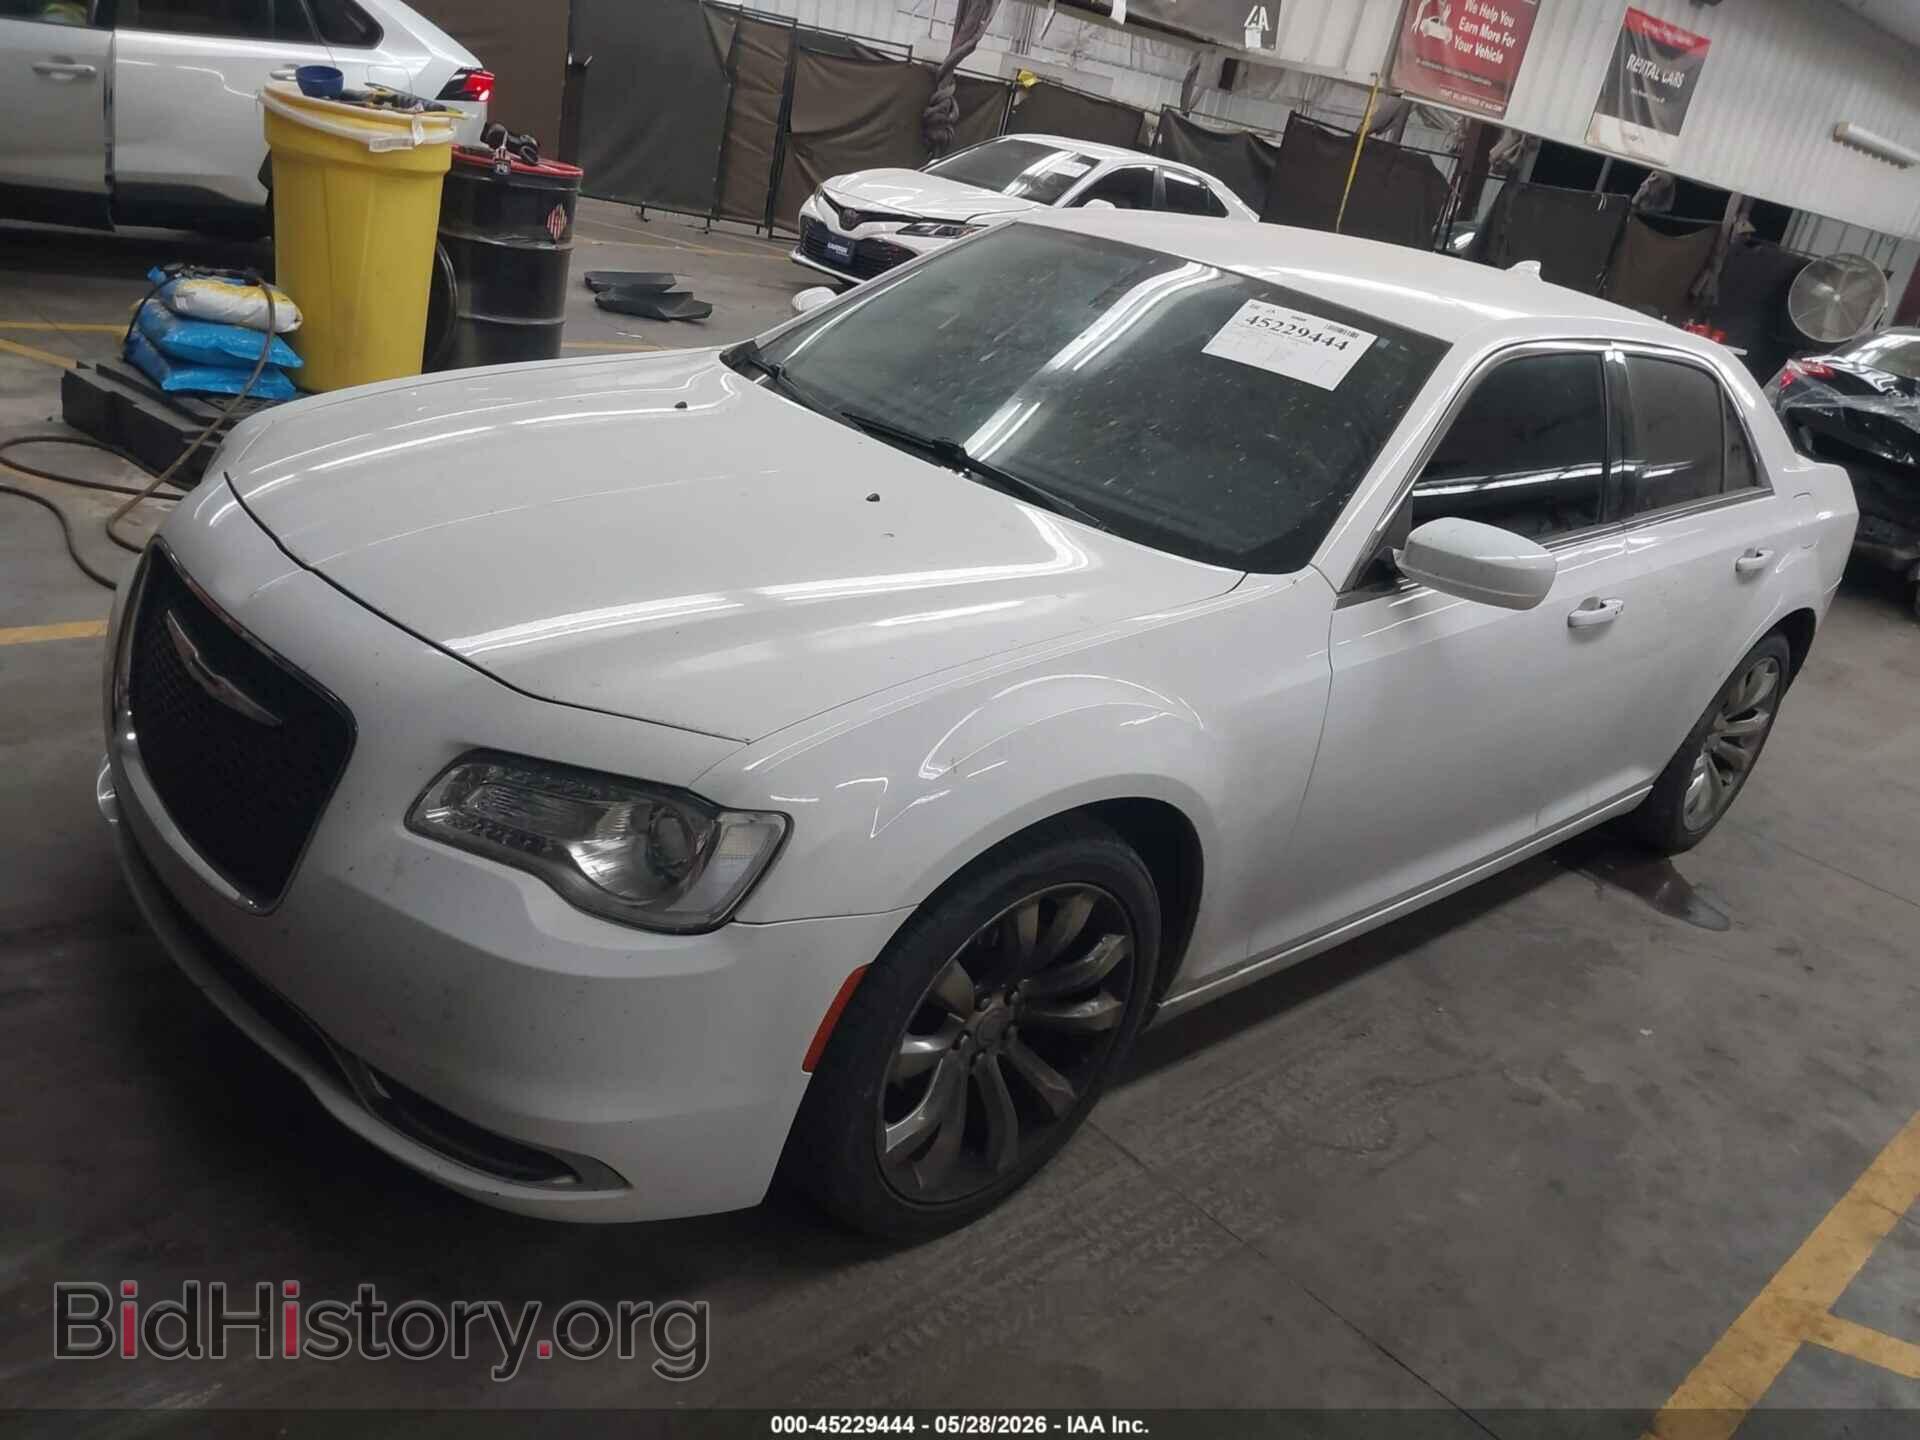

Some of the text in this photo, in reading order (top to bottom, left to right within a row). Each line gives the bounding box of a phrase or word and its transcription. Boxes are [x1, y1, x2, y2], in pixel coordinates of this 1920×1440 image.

[1479, 2, 1499, 24] Help
[1500, 10, 1515, 28] You
[1459, 16, 1516, 48] Earn More For
[1454, 35, 1503, 64] Your Vehicle
[1625, 53, 1685, 89] RENTAL CARS
[1245, 315, 1349, 351] 45229444
